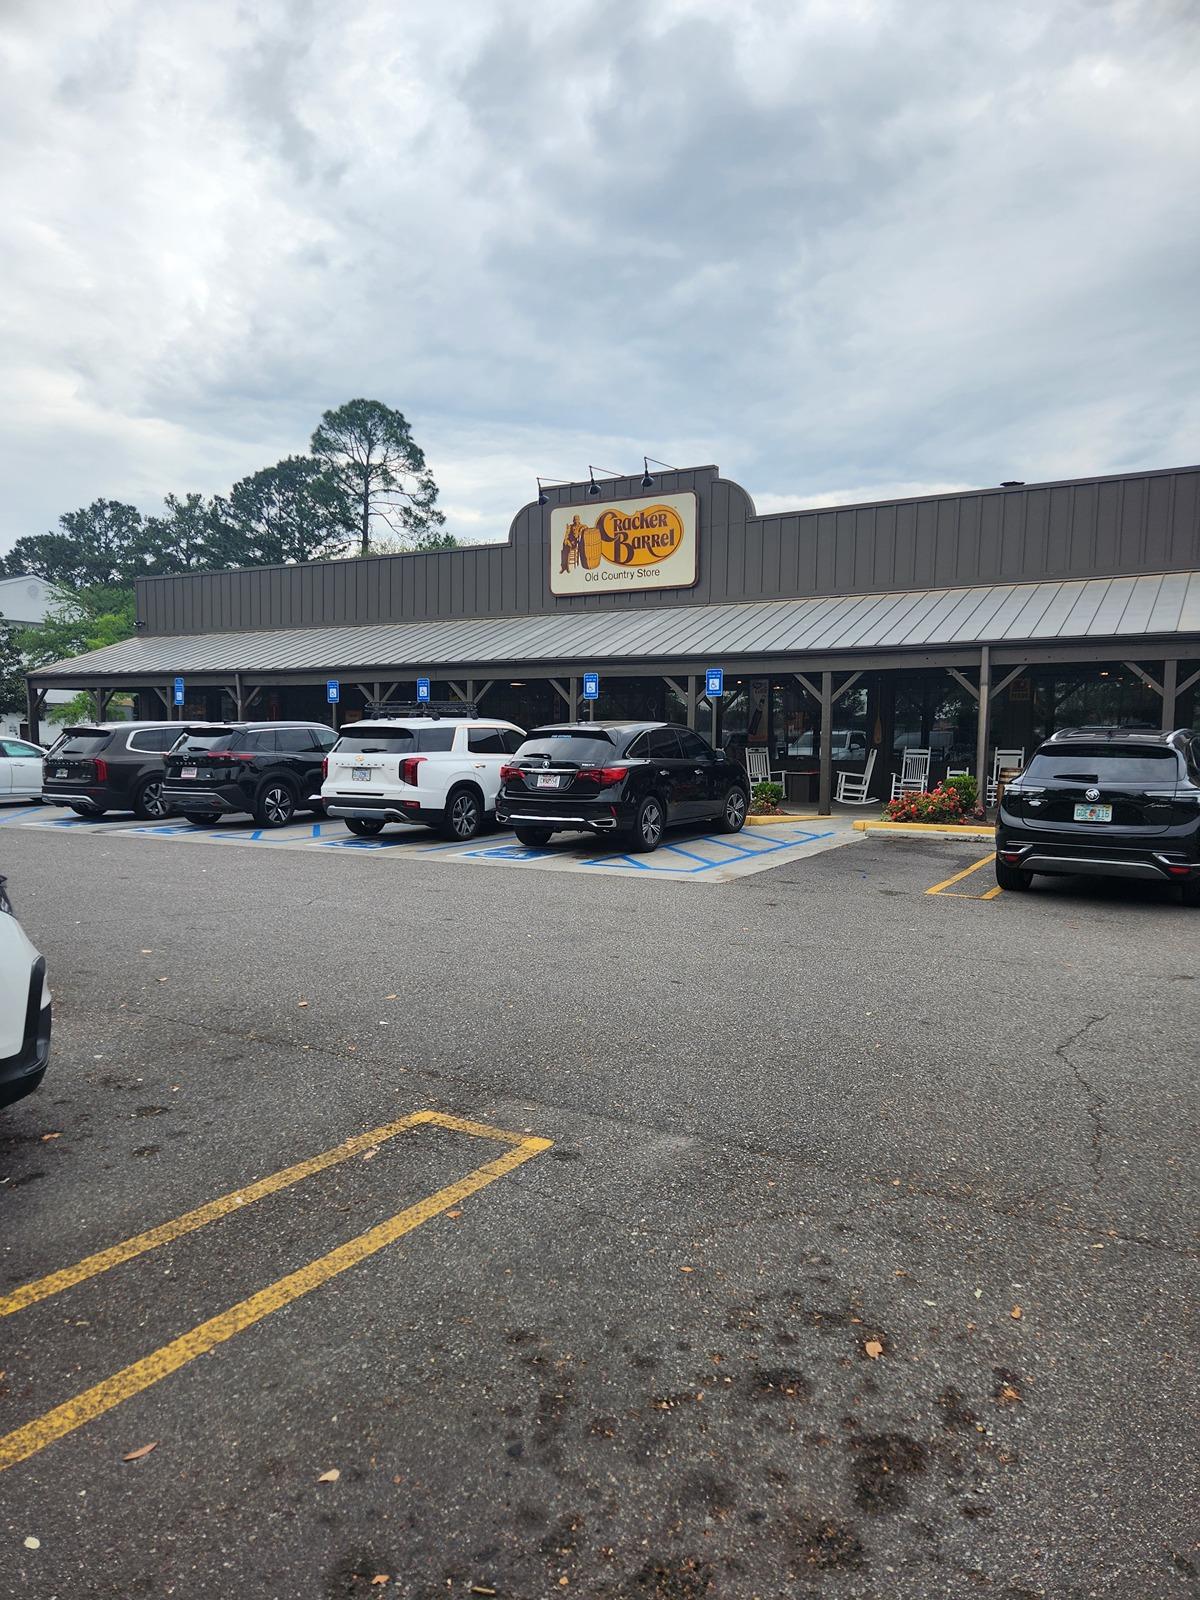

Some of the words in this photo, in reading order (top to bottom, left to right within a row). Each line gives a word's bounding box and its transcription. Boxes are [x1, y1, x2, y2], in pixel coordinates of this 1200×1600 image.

[596, 511, 668, 543] Cracker
[613, 528, 675, 565] Barrel
[585, 572, 599, 582] Old
[601, 571, 635, 581] Country
[636, 568, 661, 578] Store
